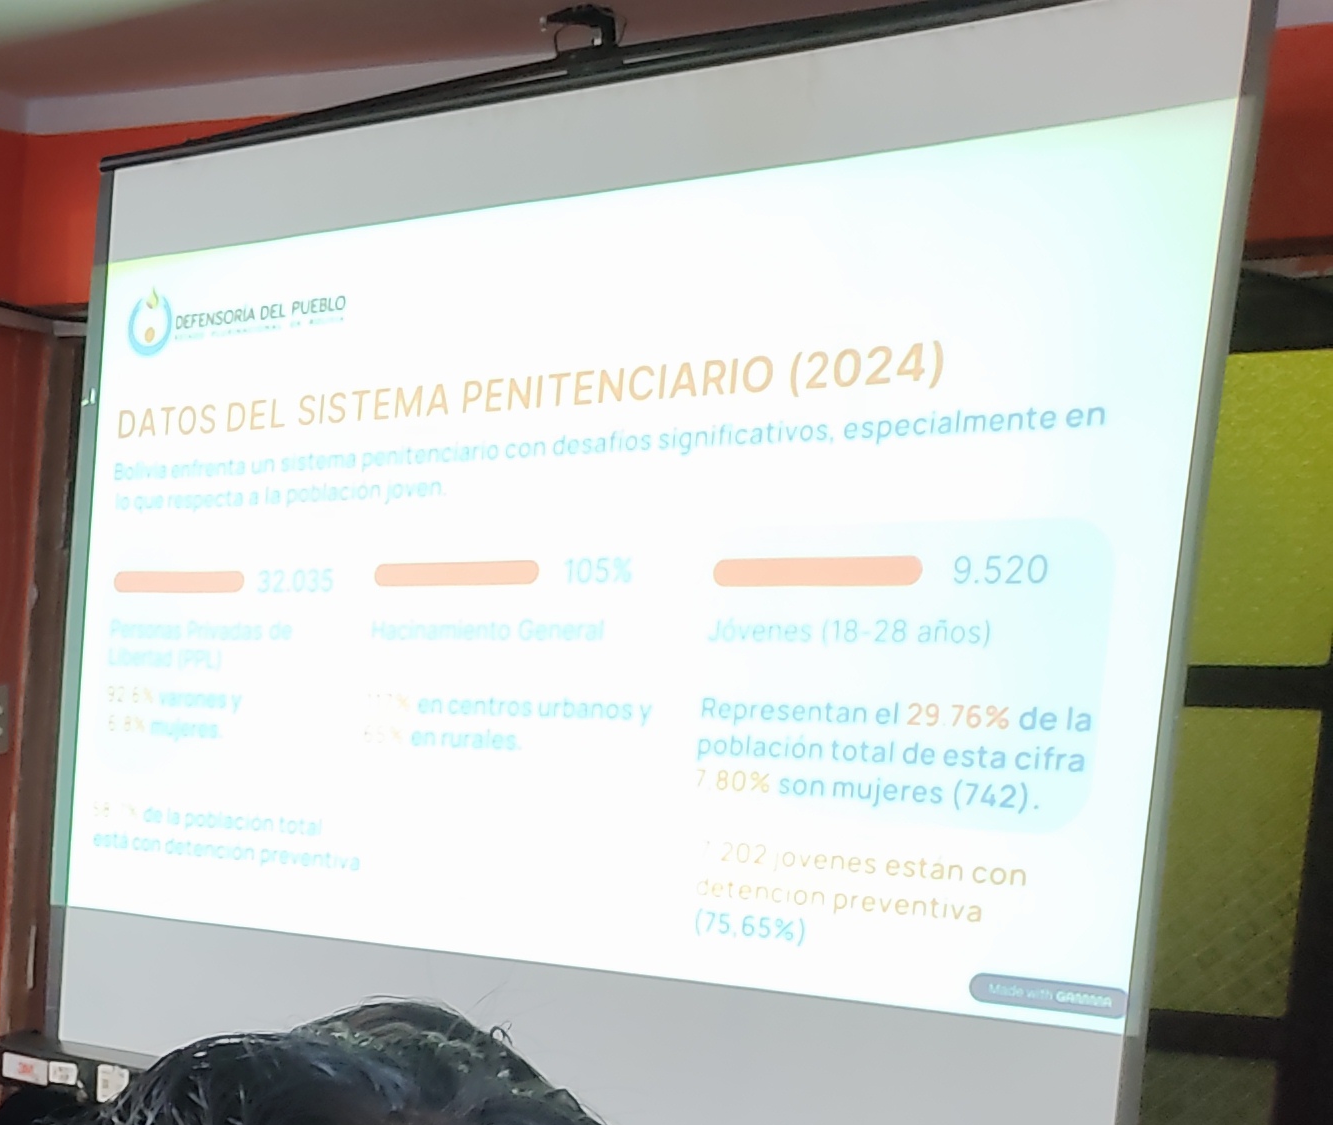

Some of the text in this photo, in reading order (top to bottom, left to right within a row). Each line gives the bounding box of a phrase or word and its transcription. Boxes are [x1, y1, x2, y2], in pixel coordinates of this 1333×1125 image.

[260, 304, 286, 321] DEL
[291, 295, 347, 316] PUEBLO
[117, 340, 946, 440] DATOS DEL SISTEMA PENITENCIARIO (2024)
[113, 460, 168, 484] Bolivia
[170, 455, 247, 482] enfrenta
[251, 458, 276, 477] un
[280, 450, 358, 476] sistema
[361, 440, 499, 474] penitenciario
[504, 438, 548, 462] con
[657, 419, 835, 456] significativos,
[842, 408, 1058, 446] especialmente
[1065, 404, 1107, 429] en
[247, 491, 260, 506] a
[264, 486, 282, 506] la
[383, 477, 447, 505] joven.
[563, 556, 634, 586] 105%
[952, 554, 1050, 586] 9.520
[186, 618, 263, 643] Privadas
[269, 619, 293, 642] de
[370, 617, 606, 644] Hacinamiento General
[821, 618, 908, 649] (18-28
[916, 619, 993, 650] años)
[230, 694, 242, 715] y
[417, 696, 443, 716] en
[447, 696, 533, 719] centros
[536, 696, 633, 722] urbanos
[639, 701, 654, 727] y
[700, 697, 1093, 734] Representan el 29.76% de la
[410, 729, 437, 749] en
[441, 727, 522, 752] rurales.
[695, 733, 1086, 774] población total de esta cifra
[778, 776, 826, 798] son
[831, 778, 944, 808] mujeres
[142, 804, 163, 826] de
[279, 813, 323, 837] total
[132, 834, 162, 853] con
[259, 844, 361, 872] preventiva
[971, 863, 1028, 888] con
[832, 890, 983, 923] preventiva
